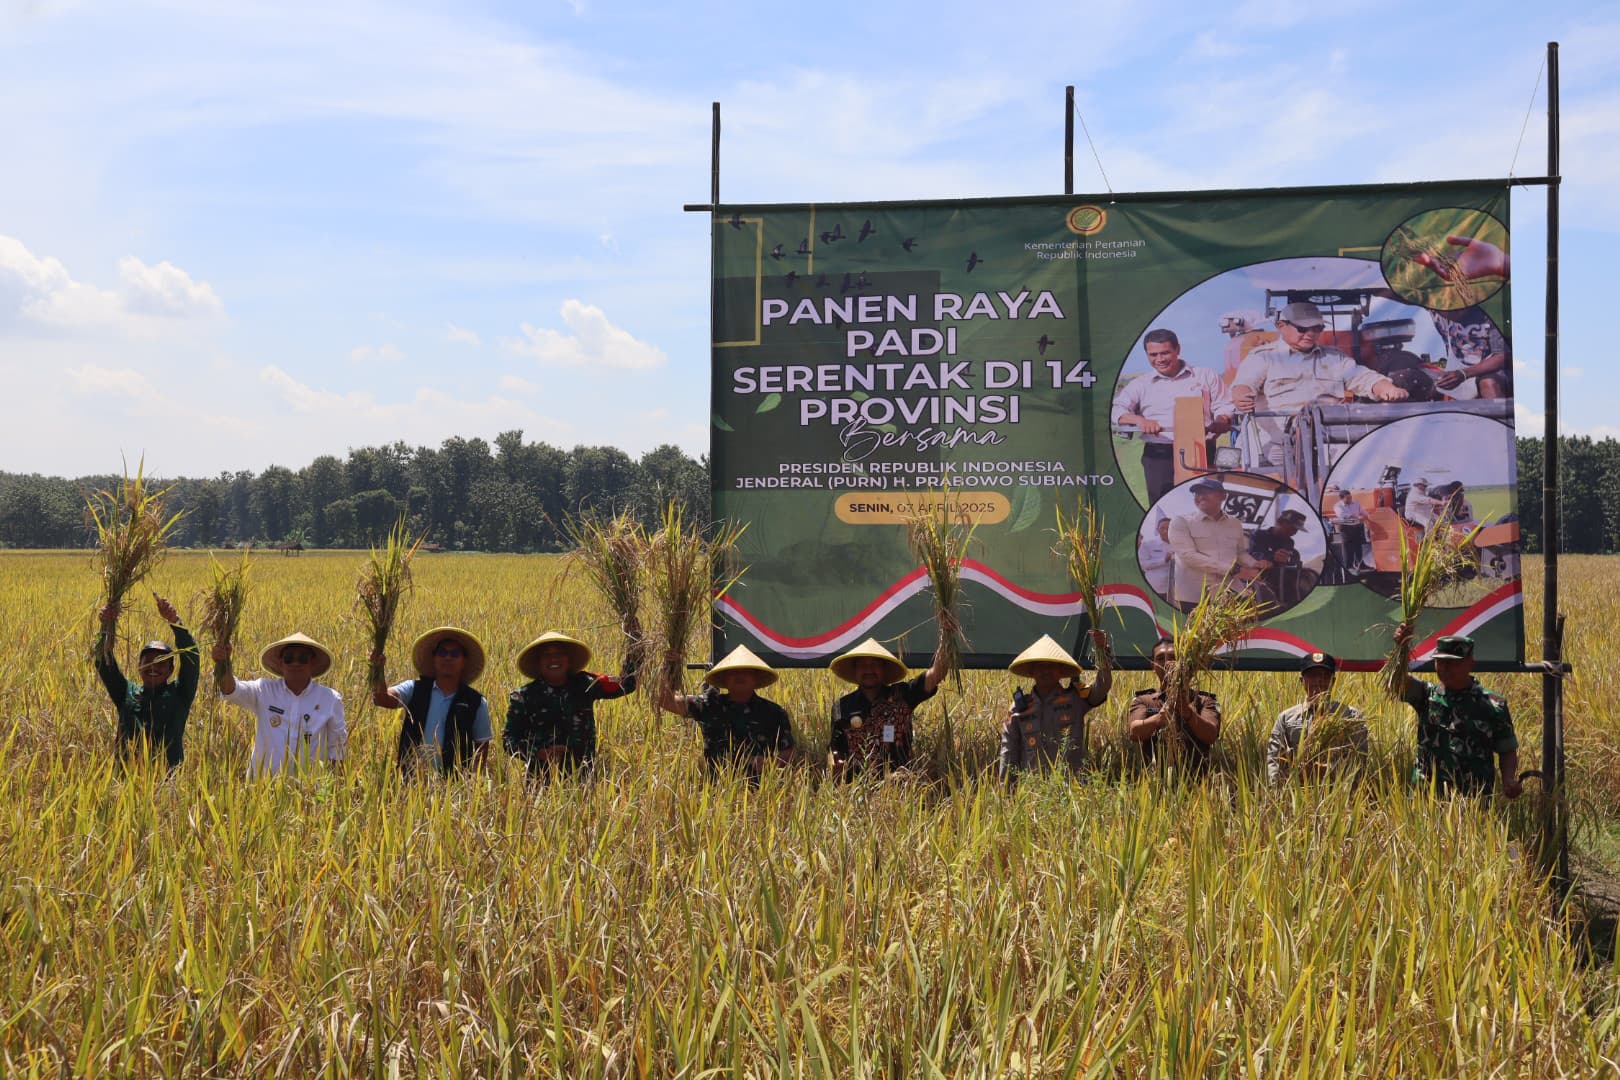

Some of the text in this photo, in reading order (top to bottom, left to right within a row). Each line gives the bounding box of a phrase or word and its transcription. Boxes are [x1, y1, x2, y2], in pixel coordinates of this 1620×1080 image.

[1024, 239, 1146, 250] Kementerian Pertanian
[1036, 249, 1137, 261] Republik Indonesia
[761, 290, 1065, 326] PANEN RAYA
[846, 327, 957, 358] PADI
[732, 360, 1098, 394] SERENTAK DI 14
[799, 395, 1020, 426] PROVINSI
[839, 415, 1008, 462] Bersama
[779, 461, 1065, 474] PRESIDEN REPUBLIK INDONESIA
[735, 474, 1114, 489] JENDERAL (PURN) H. PRABOWO SUBIANTO
[849, 503, 894, 514] SENIN,
[961, 502, 995, 513] 2025
